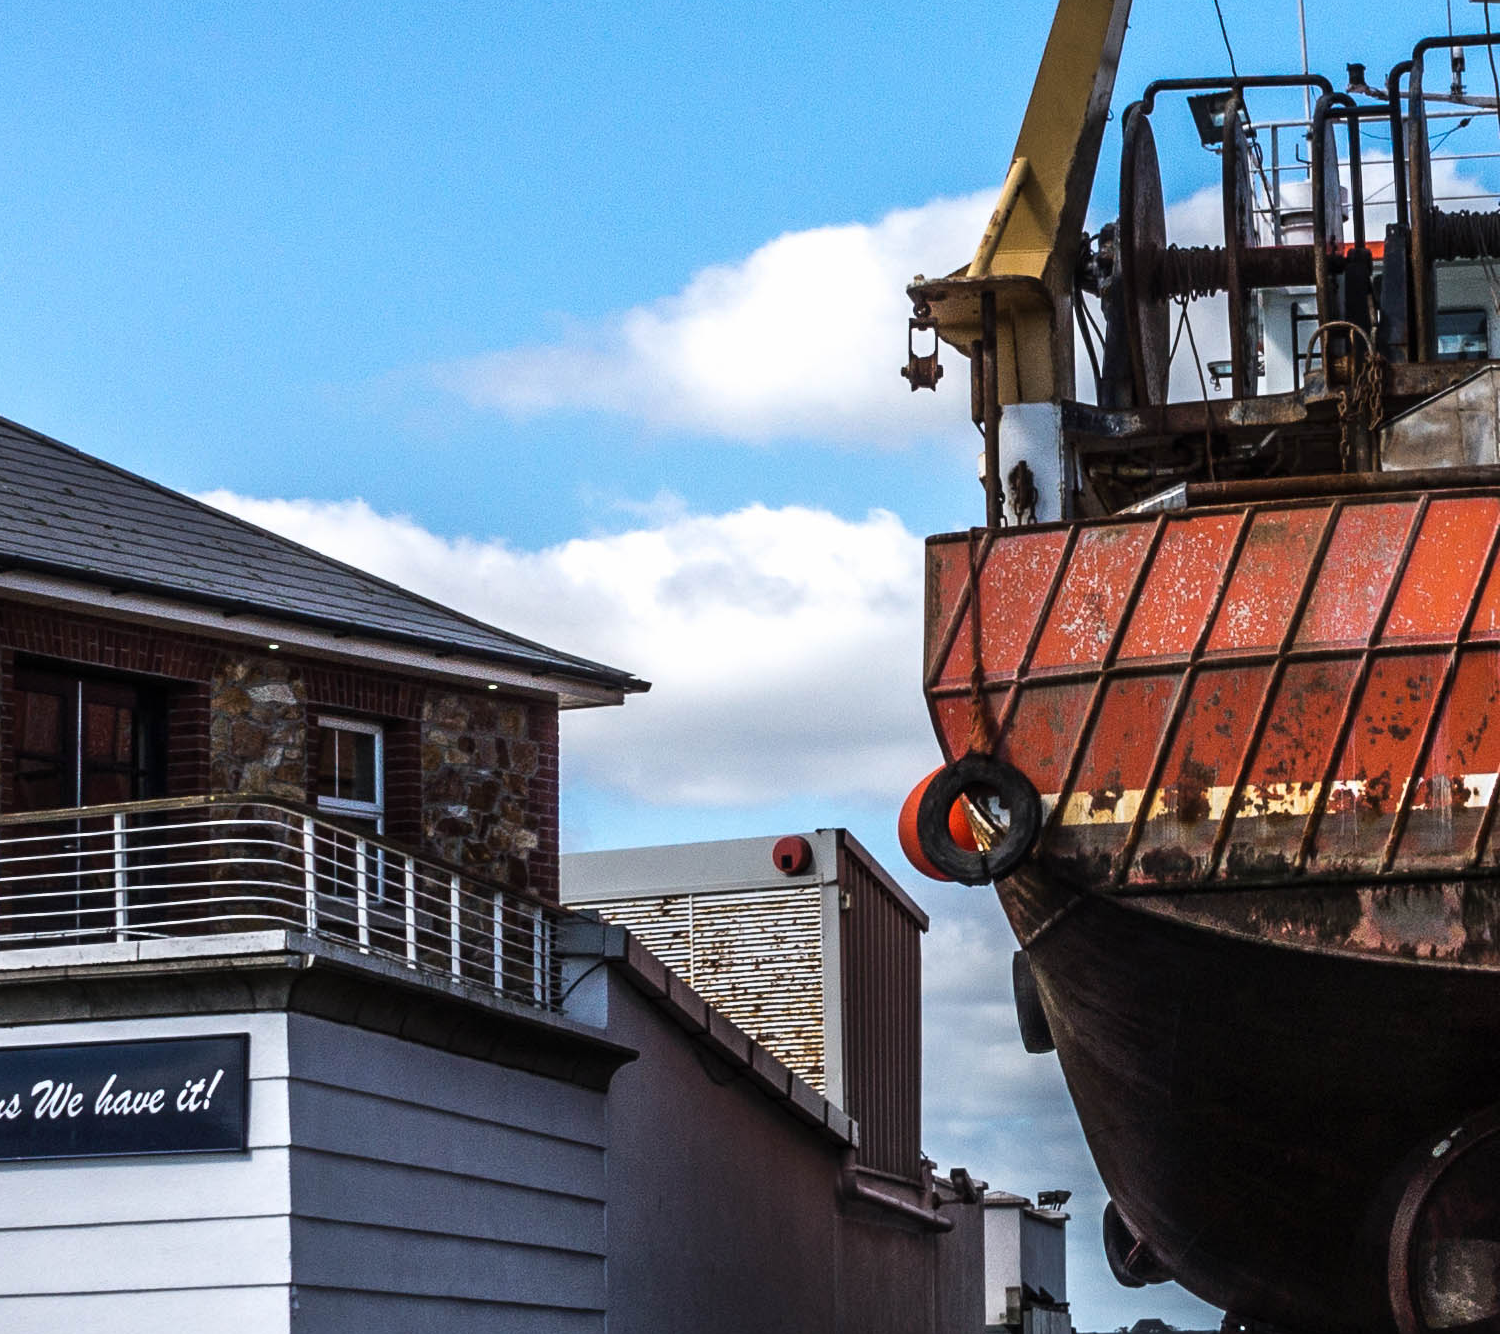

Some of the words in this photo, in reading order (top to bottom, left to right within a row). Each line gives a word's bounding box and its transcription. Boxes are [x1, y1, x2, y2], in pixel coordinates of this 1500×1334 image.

[31, 1079, 84, 1120] We
[94, 1074, 166, 1116] have
[176, 1069, 225, 1112] it!
